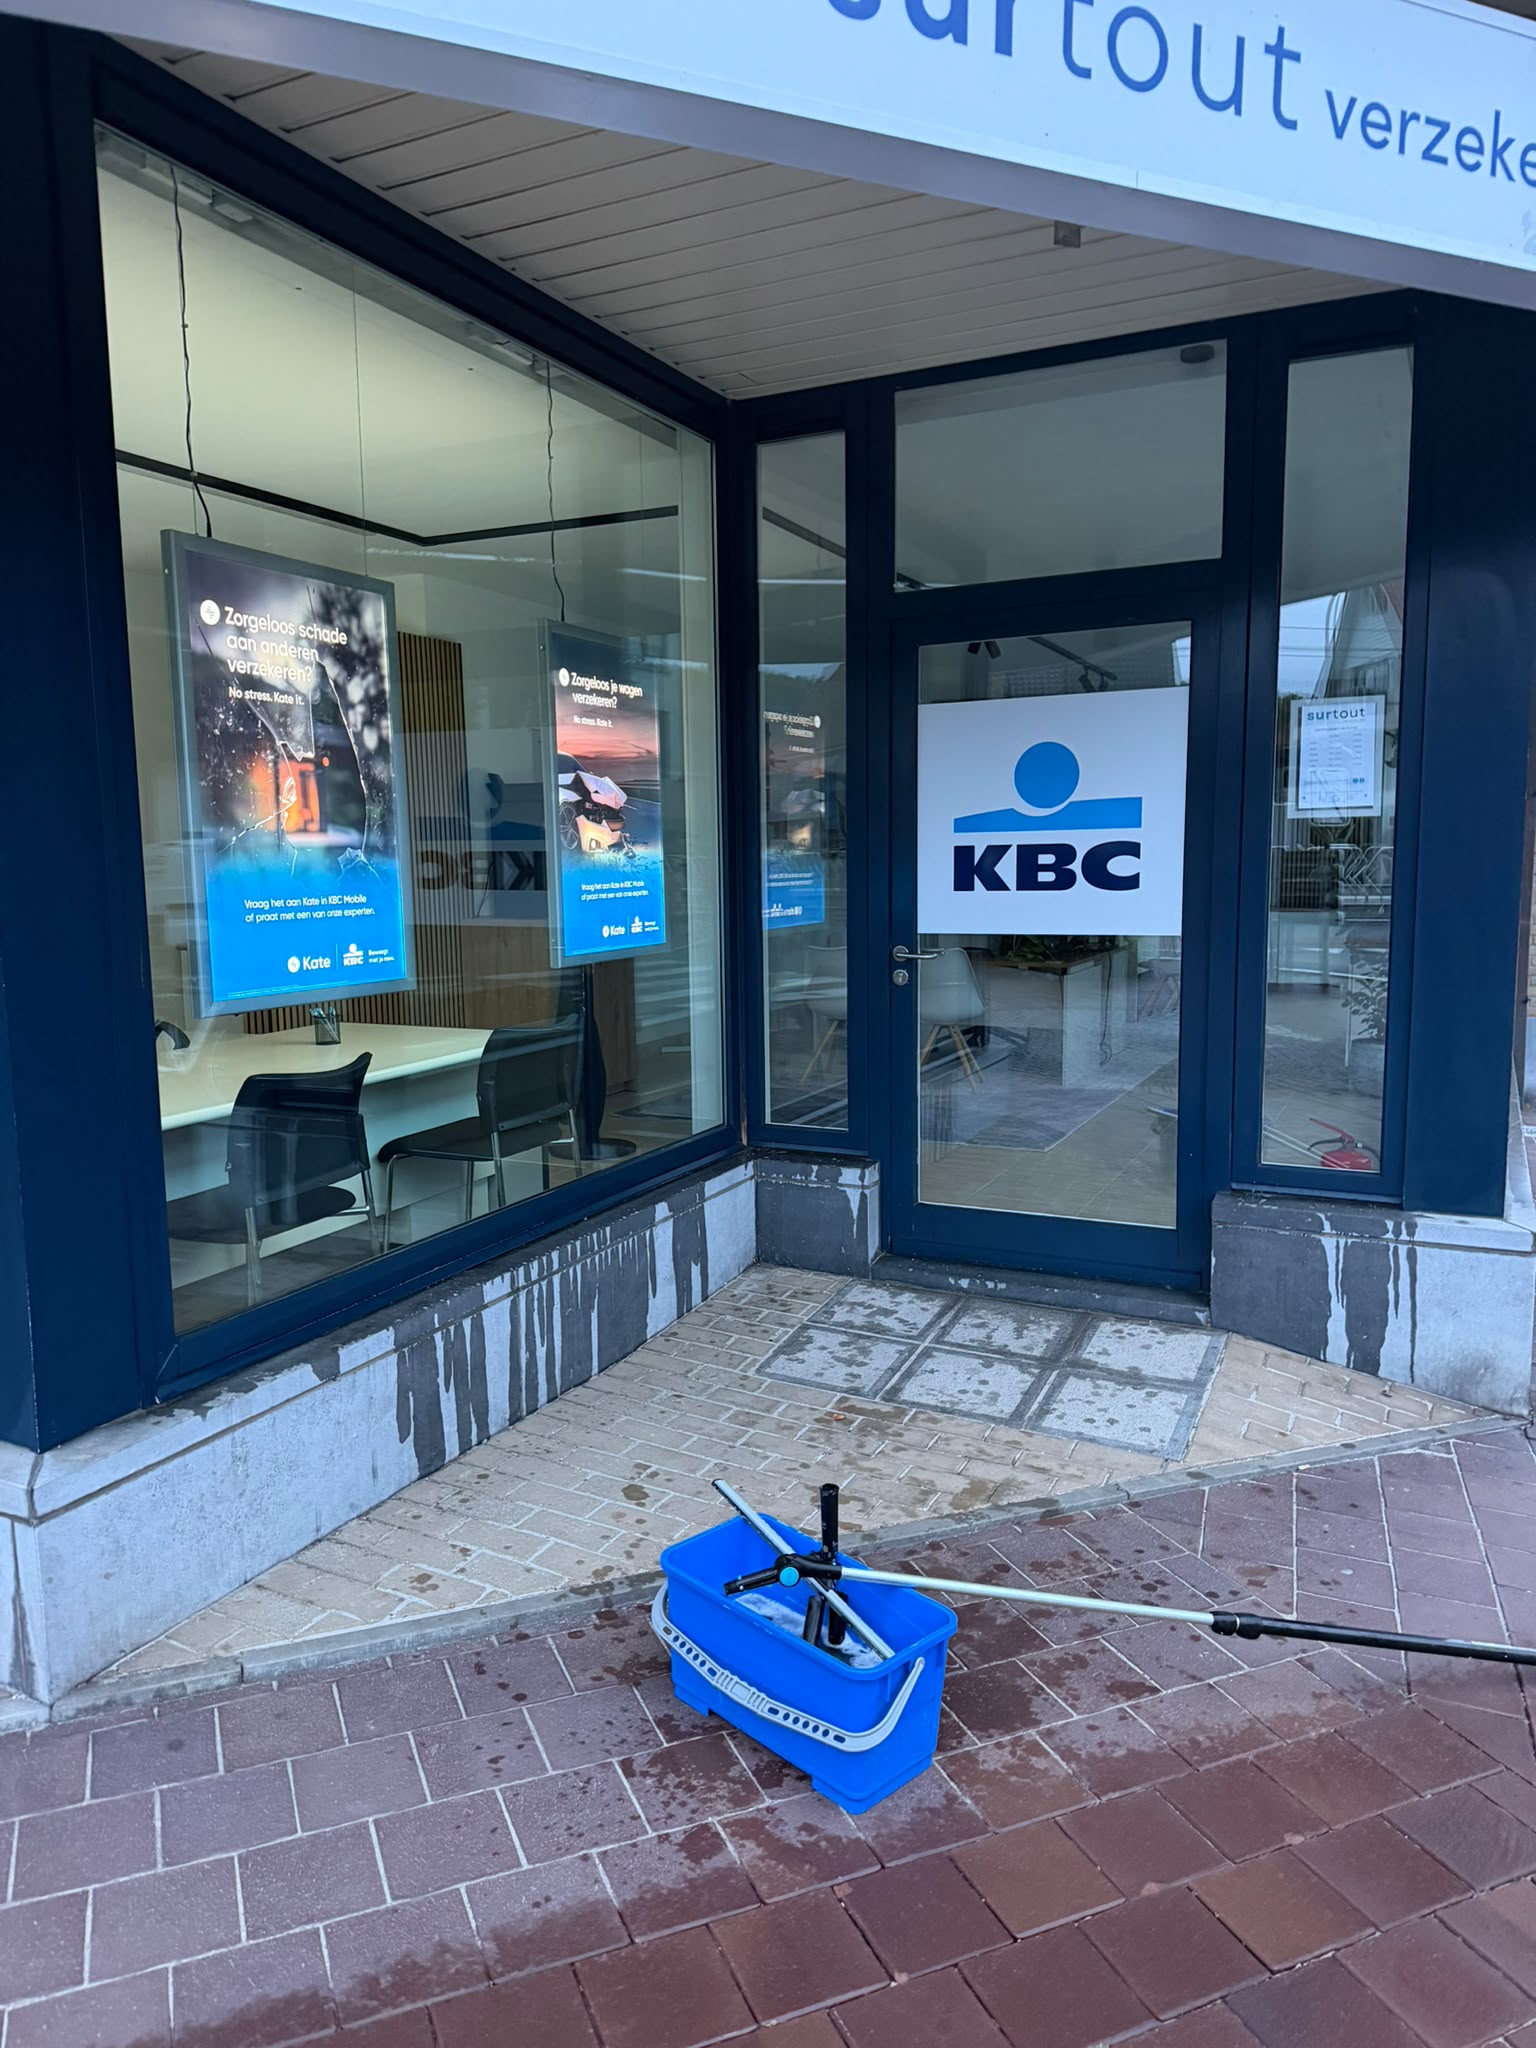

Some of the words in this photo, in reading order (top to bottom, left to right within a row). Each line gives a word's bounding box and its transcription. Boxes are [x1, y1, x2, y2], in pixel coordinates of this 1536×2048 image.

[224, 606, 295, 636] Zorgeloos
[299, 623, 347, 645] schade
[227, 635, 256, 652] aan
[261, 640, 319, 661] anderen
[227, 659, 312, 682] verzekeren?
[571, 672, 610, 691] Zorgeloos
[610, 679, 618, 695] je
[229, 686, 242, 698] No
[244, 689, 273, 702] stress.
[274, 692, 294, 704] Kate
[296, 694, 305, 705] it.
[572, 693, 617, 708] verzekeren?
[1307, 708, 1365, 720] surtout
[953, 840, 1141, 891] KBC
[244, 899, 269, 910] Vraag
[271, 898, 284, 908] het
[286, 899, 301, 907] aan
[302, 897, 320, 906] Kate
[320, 896, 327, 905] in
[328, 895, 342, 905] KBC
[343, 894, 367, 904] Mobile
[245, 912, 254, 922] of
[256, 912, 278, 924] praat
[280, 911, 295, 920] met
[296, 910, 311, 919] een
[312, 910, 326, 918] van
[327, 909, 342, 917] onze
[303, 956, 331, 970] Kate
[343, 957, 364, 966] KBC
